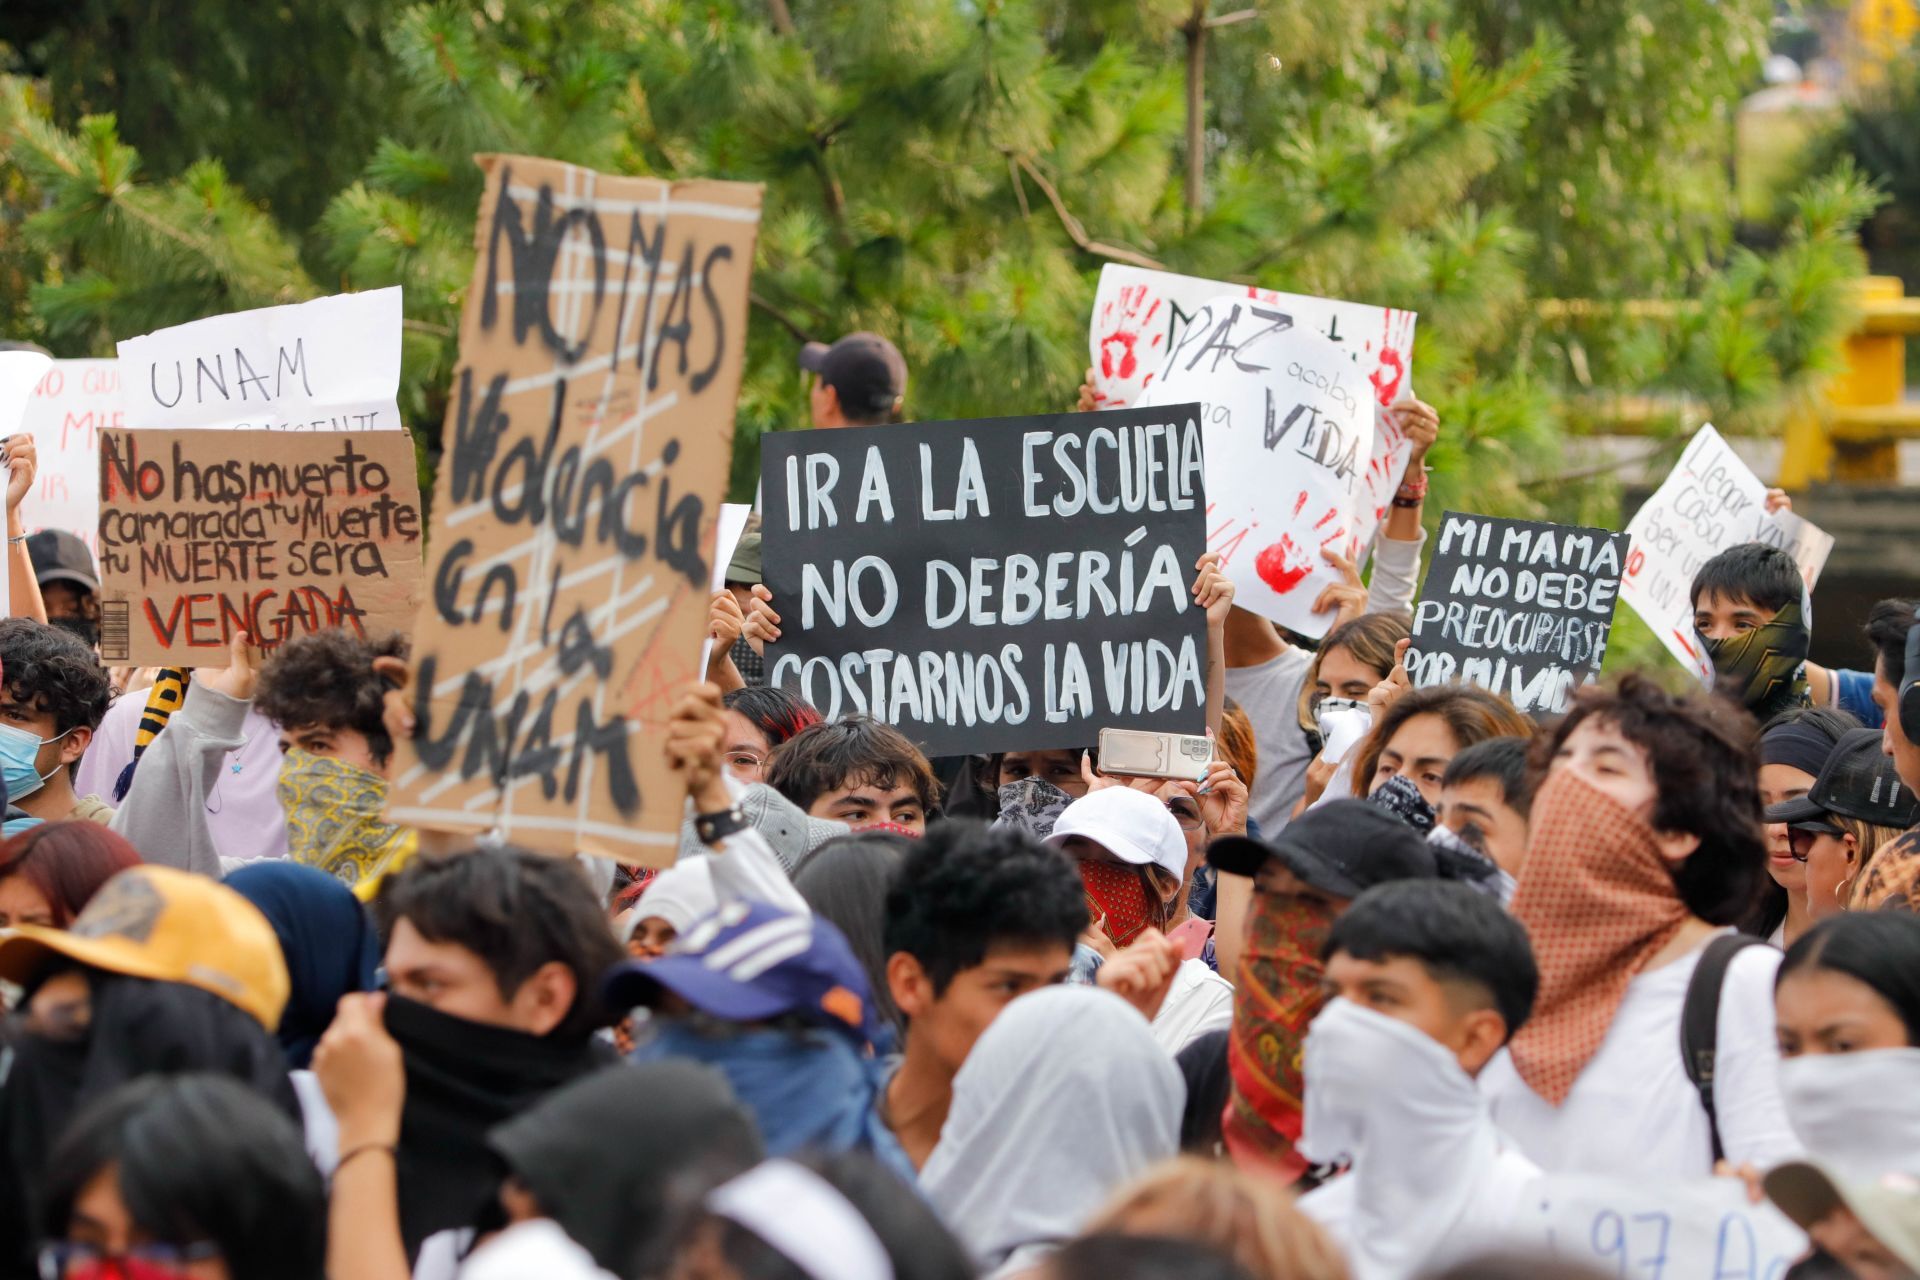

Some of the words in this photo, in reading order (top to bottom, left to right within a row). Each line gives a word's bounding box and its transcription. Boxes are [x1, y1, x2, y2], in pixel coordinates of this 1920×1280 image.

[482, 166, 606, 364] NO
[611, 206, 733, 394] MAS
[151, 338, 312, 407] UNAM
[1161, 304, 1294, 382] PAZ
[1287, 361, 1357, 418] acaba
[101, 431, 165, 502] No
[173, 440, 244, 502] has
[248, 438, 389, 497] muerto
[786, 452, 840, 532] IR
[855, 445, 895, 524] A
[919, 437, 990, 522] LA
[1022, 418, 1206, 517] ESCUELA
[1265, 387, 1361, 495] VIDA
[263, 499, 299, 525] tu
[450, 367, 708, 589] Violencia
[100, 547, 129, 575] tu
[139, 539, 278, 587] MUERTE
[1439, 517, 1492, 557] MI
[801, 555, 898, 630] NO
[925, 526, 1188, 629] DEBERÍA
[1450, 563, 1510, 598] NO
[1514, 569, 1620, 614] DEBE
[142, 583, 367, 650] VENGADA
[541, 562, 614, 682] la
[1412, 600, 1611, 671] PREOCUPARSE
[771, 643, 1030, 728] COSTARNOS
[1044, 641, 1093, 723] LA
[1101, 635, 1206, 715] VIDA
[1403, 647, 1457, 690] POR
[1461, 655, 1508, 695] MI
[412, 655, 642, 820] UNAM
